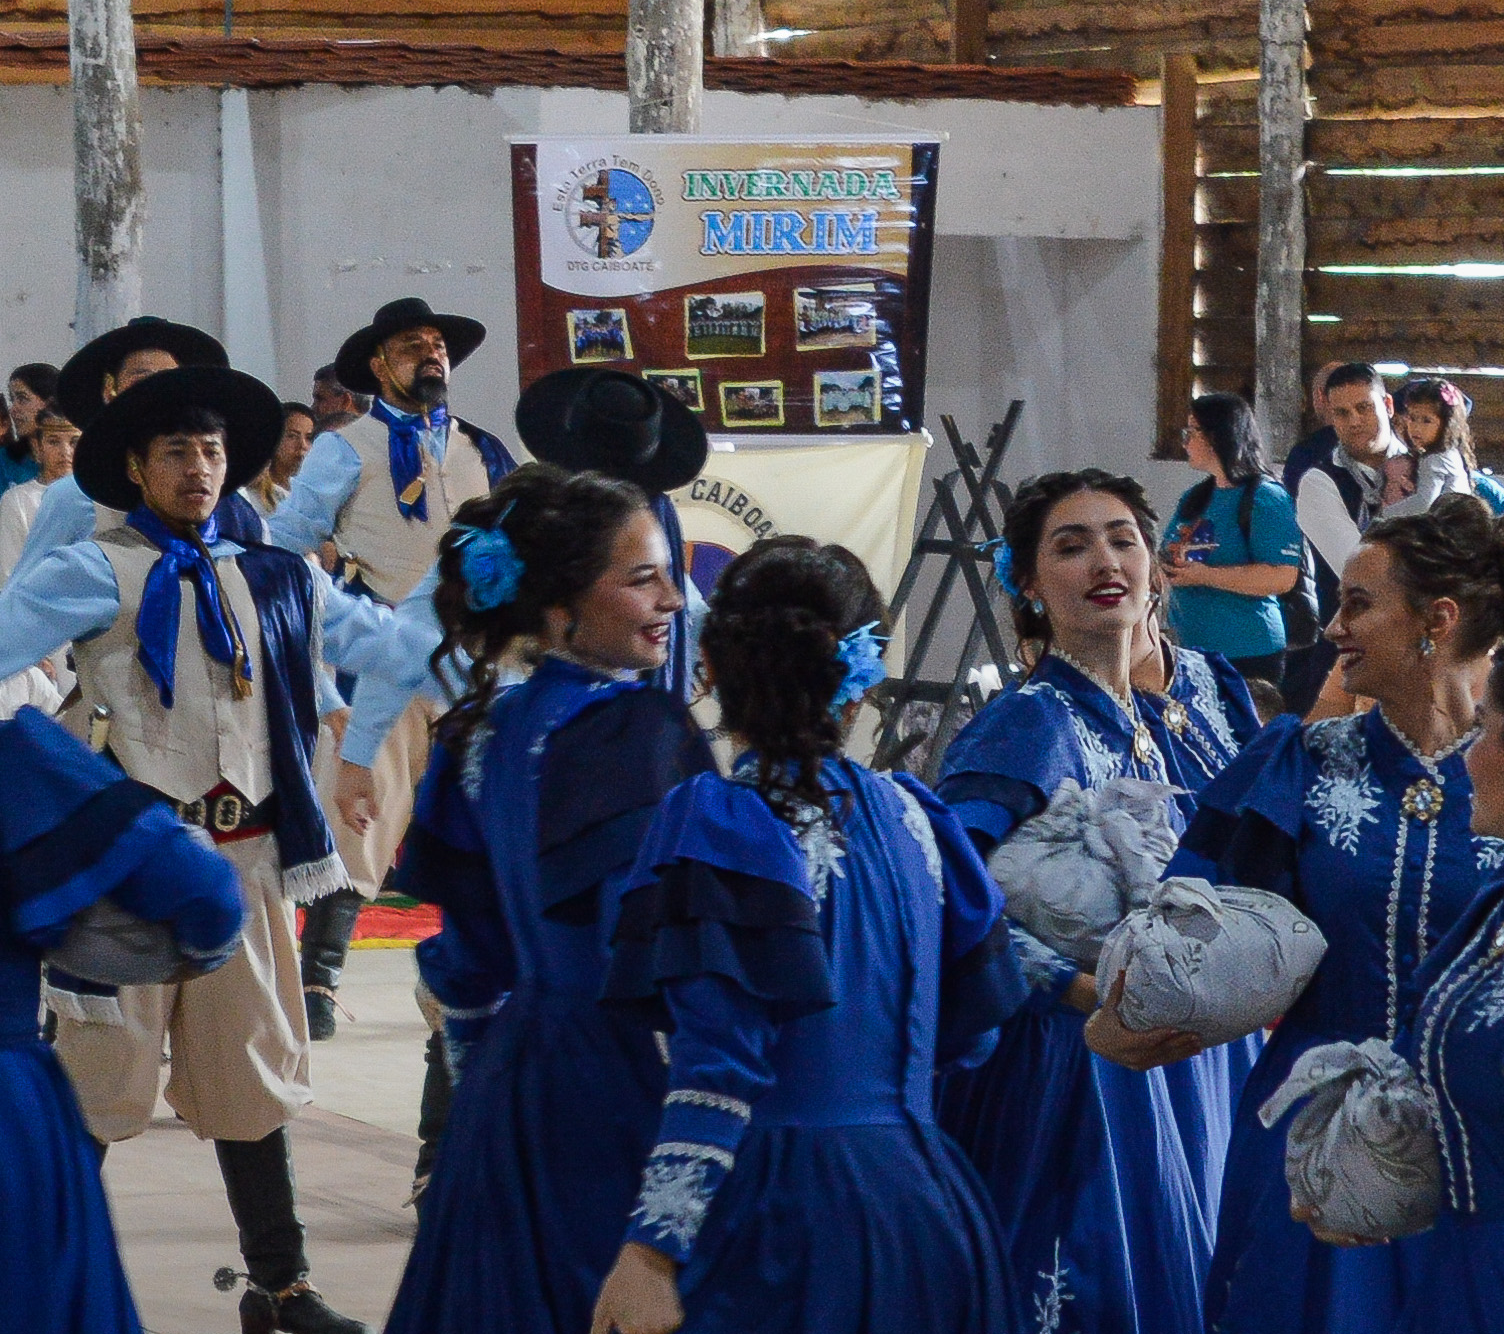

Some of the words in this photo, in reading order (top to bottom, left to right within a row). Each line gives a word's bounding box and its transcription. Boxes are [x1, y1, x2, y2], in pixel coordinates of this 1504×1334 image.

[552, 181, 571, 212] Esta
[570, 158, 607, 179] Terra
[612, 154, 640, 172] Tem
[683, 169, 901, 201] INVERNADA
[700, 210, 879, 256] MIRIM
[567, 260, 590, 272] DTG
